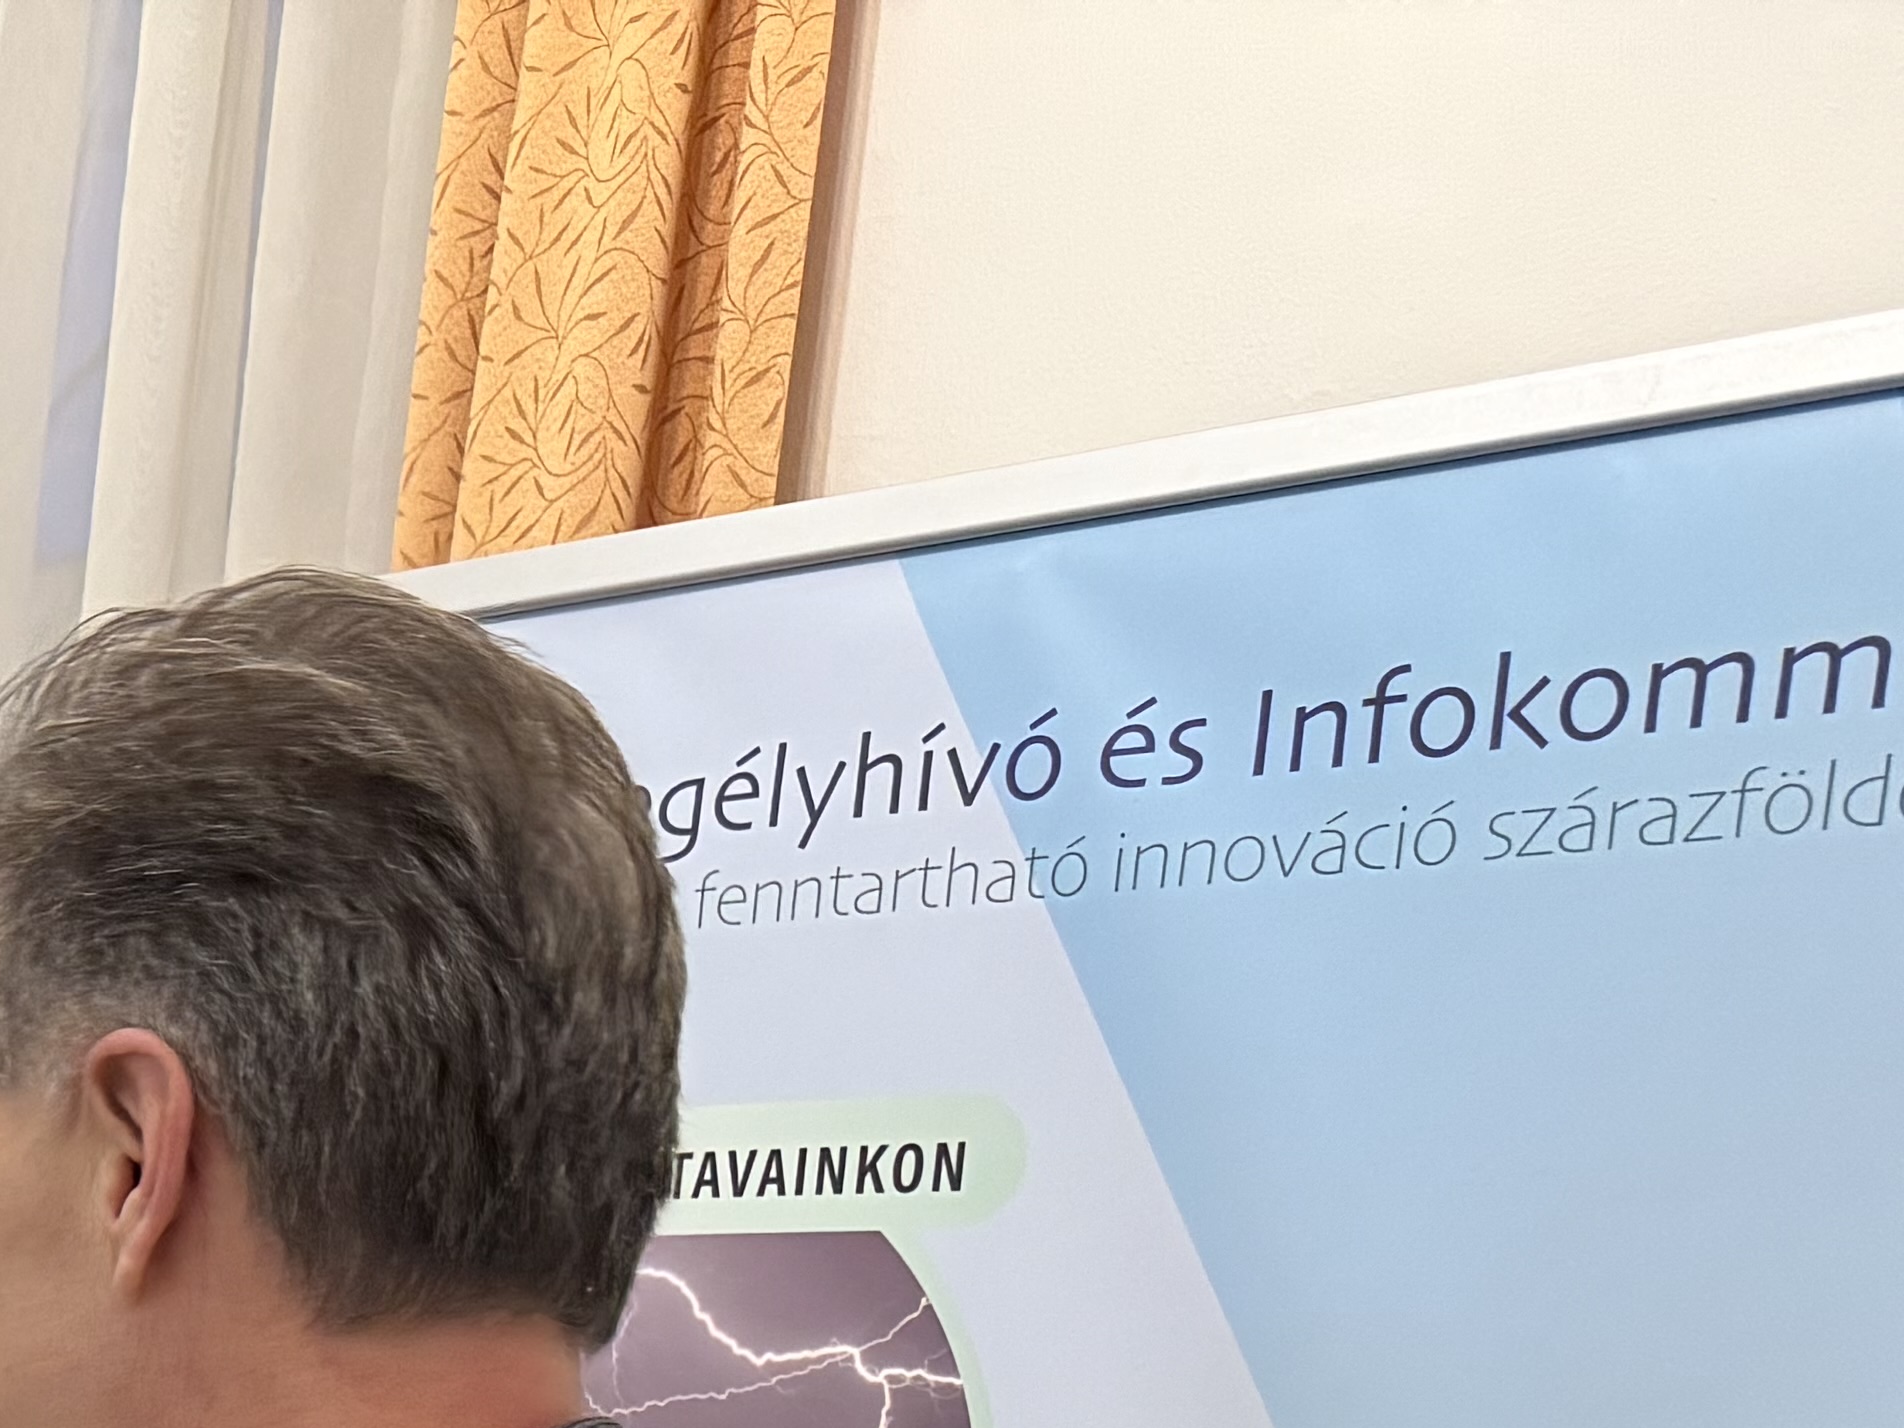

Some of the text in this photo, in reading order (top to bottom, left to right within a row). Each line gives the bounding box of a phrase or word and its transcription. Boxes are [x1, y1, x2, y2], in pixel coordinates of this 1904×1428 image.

[636, 635, 1891, 863] gélyhívó és Infokomm
[695, 753, 1904, 928] fenntartható innováció szárazföld
